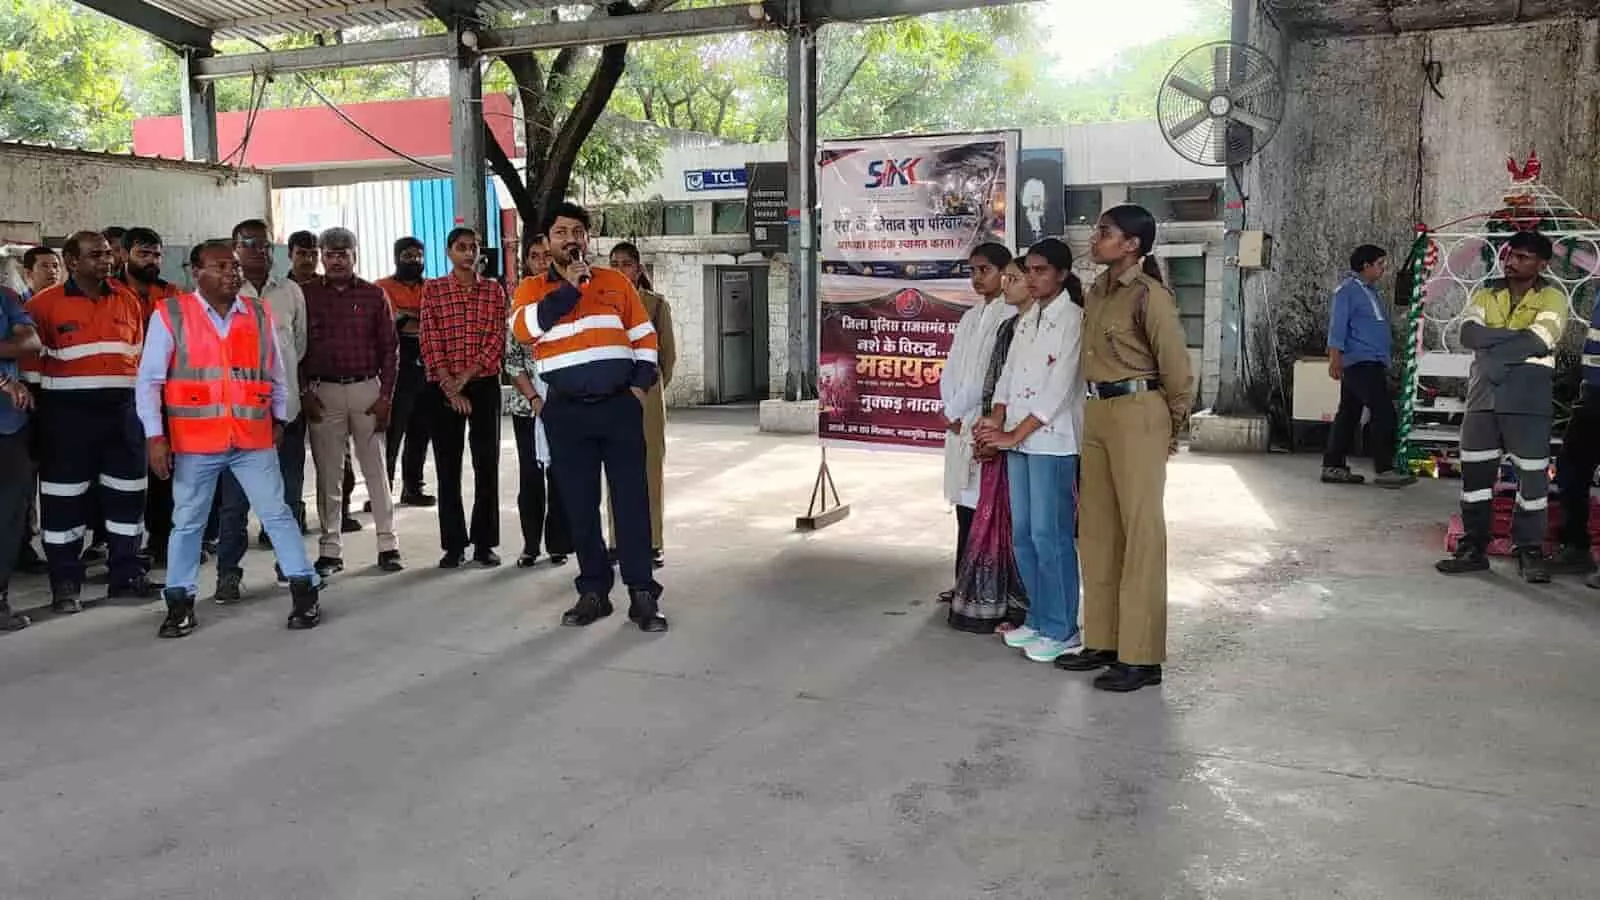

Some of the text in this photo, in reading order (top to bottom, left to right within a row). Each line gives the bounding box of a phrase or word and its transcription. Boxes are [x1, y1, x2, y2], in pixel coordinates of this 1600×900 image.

[712, 171, 737, 183] TCL
[842, 315, 868, 330] जिला
[870, 316, 899, 334] पुलिस
[901, 318, 945, 334] राजसमंद
[857, 336, 880, 353] नशे
[883, 336, 896, 353] के
